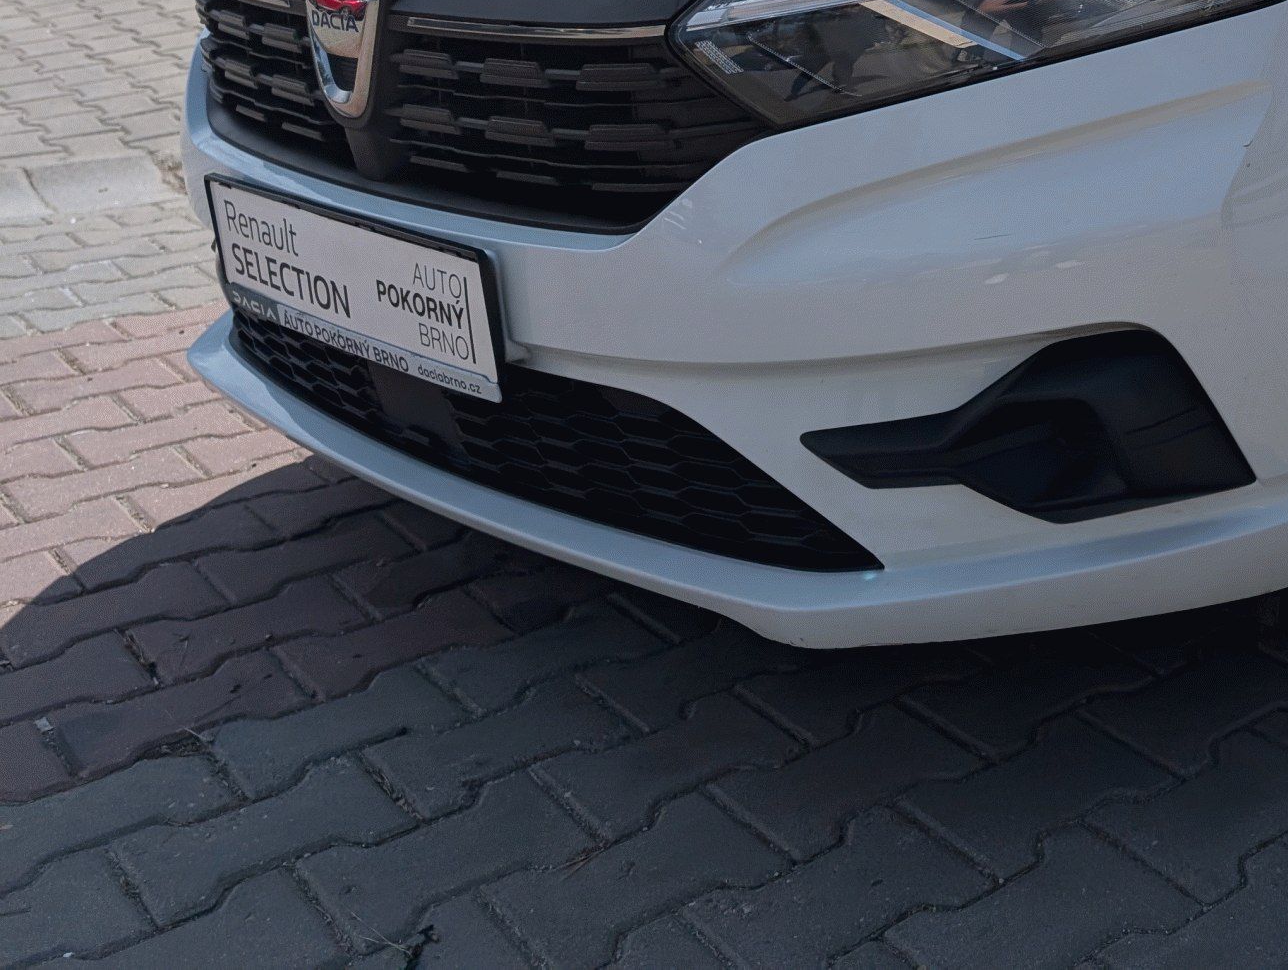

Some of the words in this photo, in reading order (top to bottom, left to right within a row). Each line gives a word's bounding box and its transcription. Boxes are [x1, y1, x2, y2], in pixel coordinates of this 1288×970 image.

[311, 10, 359, 33] DACIA
[224, 199, 299, 257] Renault
[232, 242, 351, 319] SELECTION
[413, 262, 462, 299] AUTO
[232, 290, 277, 320] DACIA
[376, 279, 464, 330] POKORNÝ
[372, 346, 409, 373] BRNO
[418, 322, 470, 361] BRNO
[417, 364, 482, 394] daciabrno.cz
